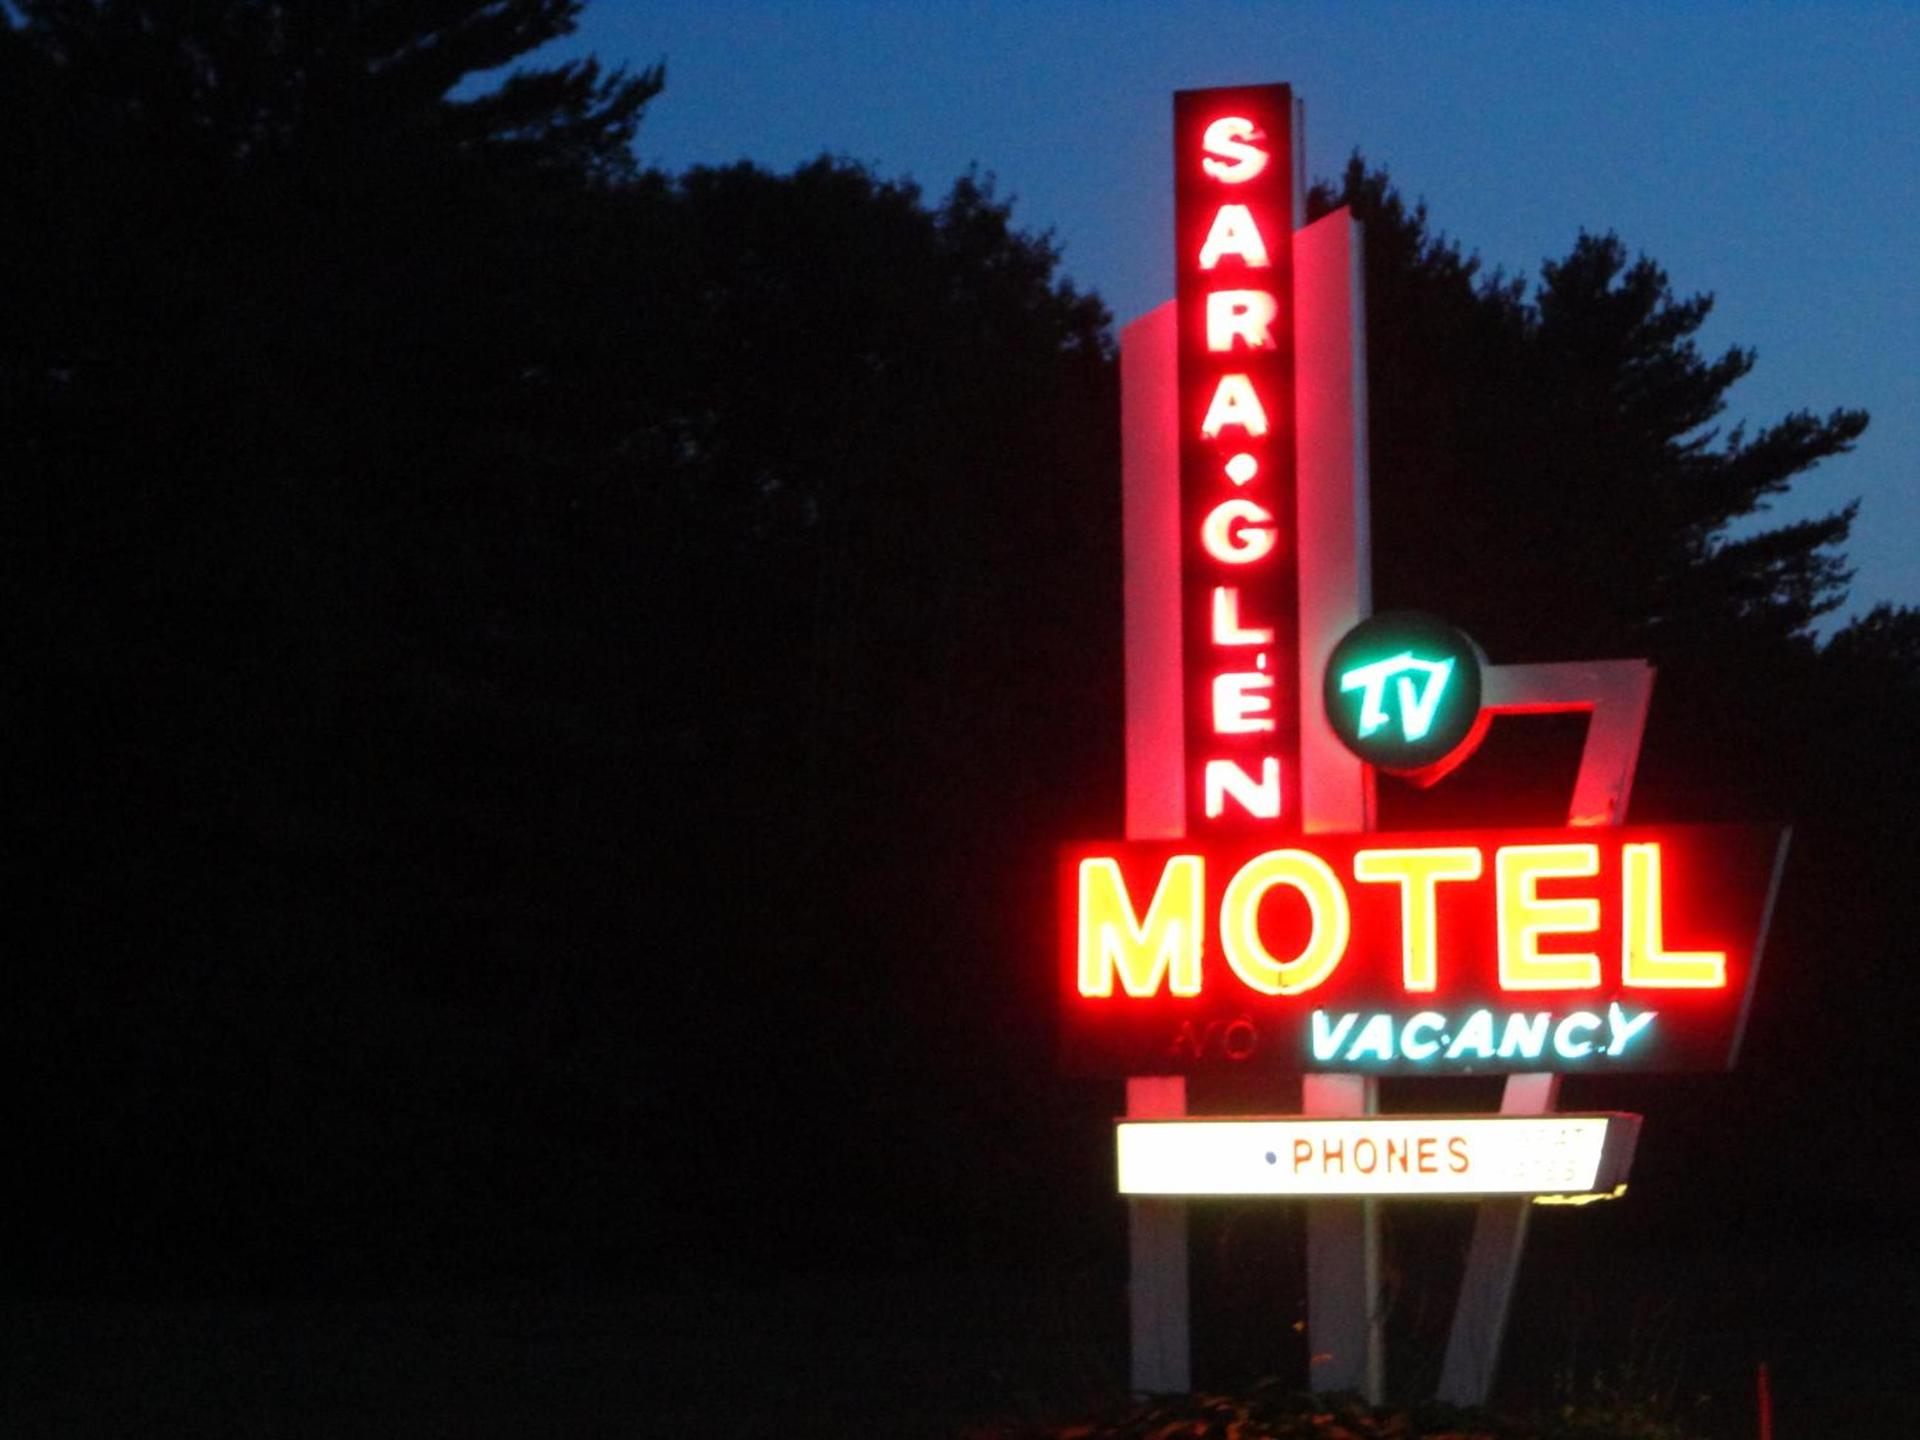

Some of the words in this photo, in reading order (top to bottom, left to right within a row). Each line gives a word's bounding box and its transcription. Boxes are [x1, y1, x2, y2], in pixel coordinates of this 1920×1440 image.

[1339, 651, 1457, 743] TV
[1077, 842, 1727, 999] MOTEL
[1311, 1001, 1658, 1061] VACANCY
[1293, 1136, 1470, 1175] PHONES
